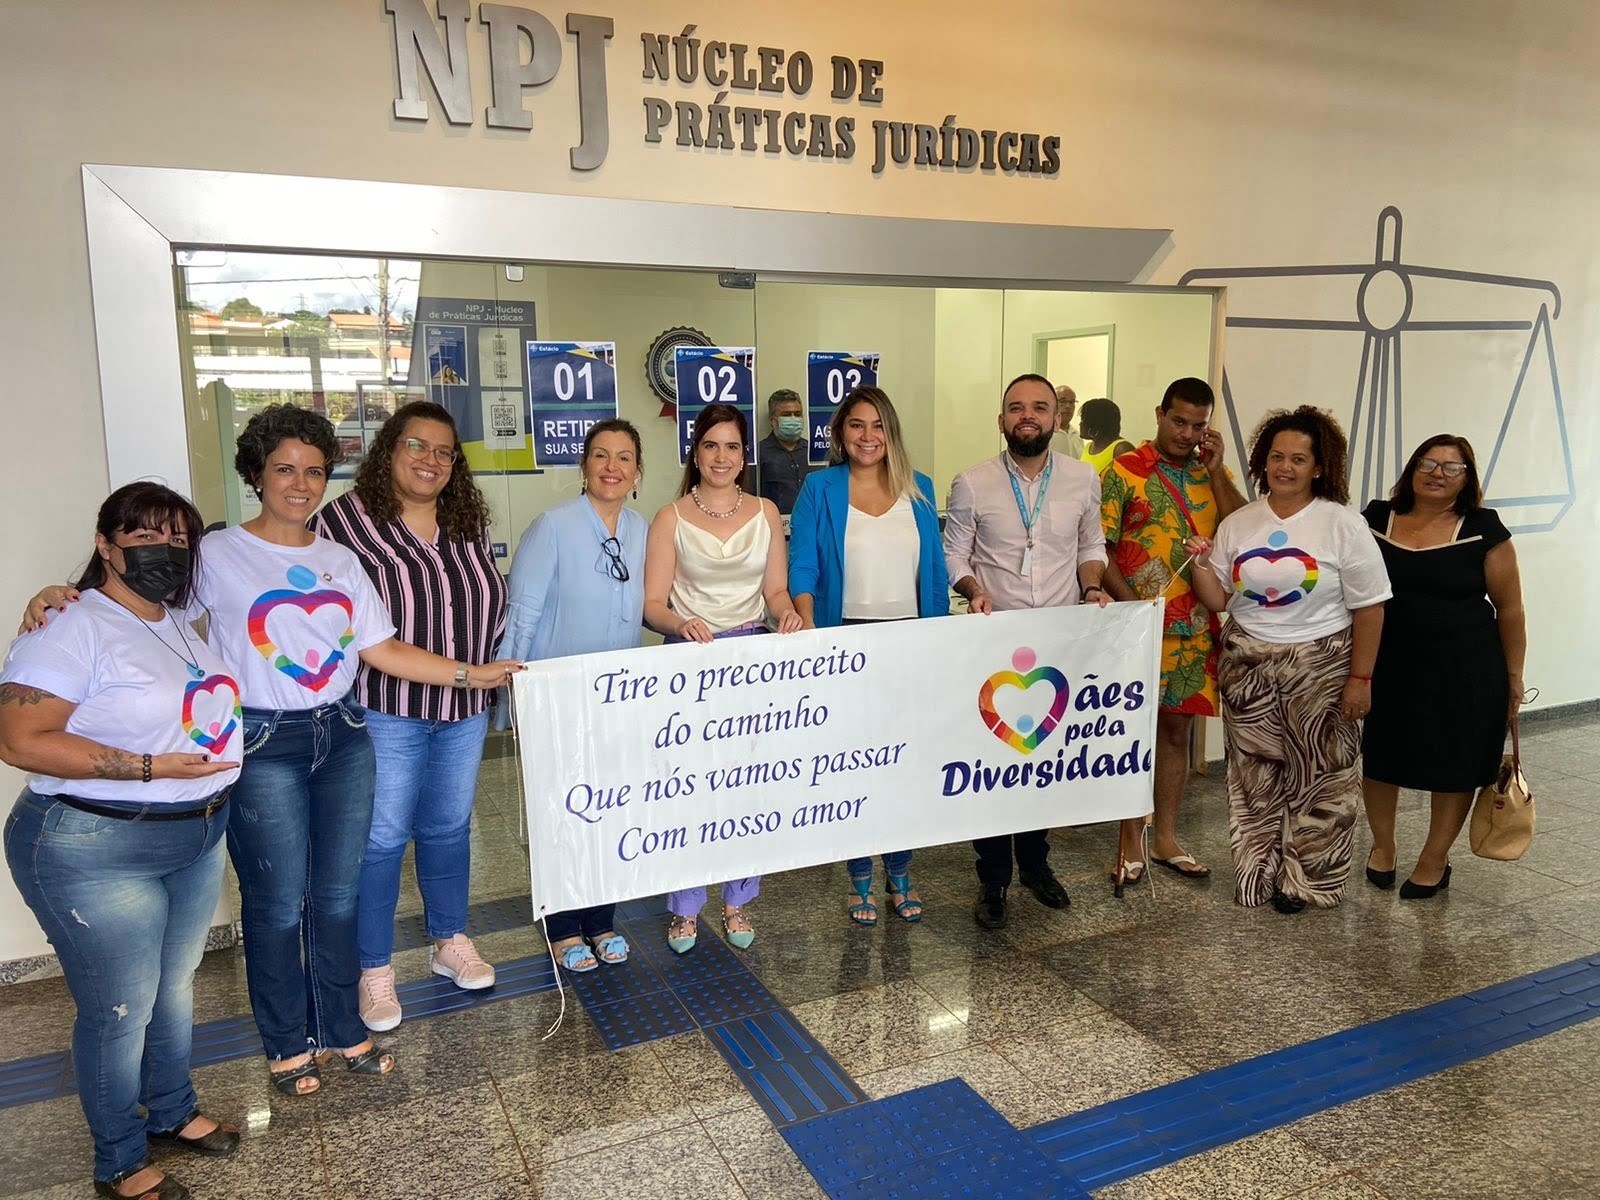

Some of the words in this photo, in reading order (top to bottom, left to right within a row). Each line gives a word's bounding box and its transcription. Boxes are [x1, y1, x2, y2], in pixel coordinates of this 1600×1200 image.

[386, 0, 614, 170] NPJ
[641, 25, 813, 97] NÚCLEO
[830, 55, 884, 103] DE
[642, 91, 856, 160] PRÁTICAS
[871, 115, 1062, 175] JURÍDICAS
[429, 311, 440, 319] de
[465, 304, 485, 313] NPJ
[553, 362, 594, 401] 01
[697, 365, 738, 402] 02
[545, 443, 569, 455] SUA
[594, 667, 659, 705] Tire
[669, 672, 687, 695] o
[695, 645, 867, 703] preconceito
[654, 711, 692, 749] do
[702, 694, 829, 743] caminho
[1064, 714, 1126, 747] pela
[564, 783, 632, 824] Que
[642, 766, 697, 803] nós
[705, 757, 804, 793] vamos
[810, 741, 907, 788] passar
[617, 826, 688, 863] Com
[698, 811, 783, 846] nosso
[791, 795, 868, 829] amor
